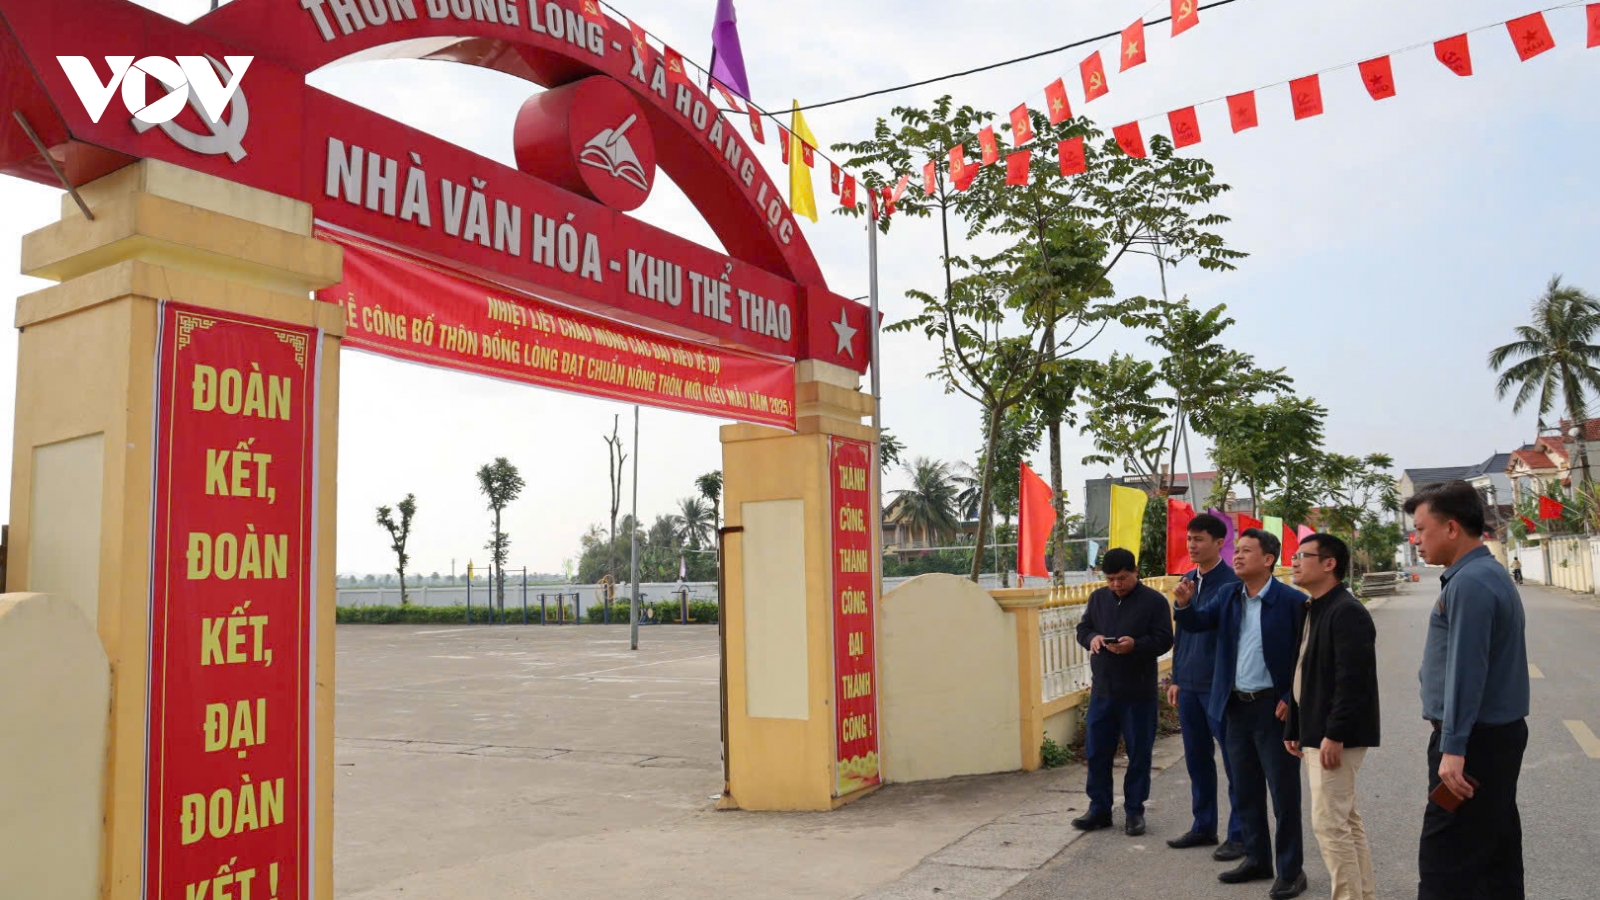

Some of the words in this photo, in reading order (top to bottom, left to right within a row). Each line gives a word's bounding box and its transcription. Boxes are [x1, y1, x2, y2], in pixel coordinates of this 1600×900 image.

[325, 136, 431, 227] NHÀ
[440, 176, 522, 257] VĂN
[533, 211, 602, 283] HÓA
[627, 248, 682, 307] KHU
[689, 263, 732, 324] THỂ
[738, 288, 791, 342] THAO
[756, 181, 794, 244] LỘC
[487, 297, 527, 330] NHIỆT
[528, 308, 556, 337] LIỆT
[557, 316, 592, 342] CHÀO
[362, 304, 407, 341] CÔNG
[412, 313, 435, 346] BỐ
[439, 324, 478, 356] THÔN
[524, 339, 559, 371] LÒNG
[561, 352, 585, 380] ĐẠT
[588, 354, 625, 386] CHUẨN
[627, 364, 656, 391] NÔNG
[658, 372, 683, 397] THÔN
[749, 390, 769, 413] NĂM
[192, 362, 291, 421] ĐOÀN
[205, 437, 276, 504] KẾT,
[839, 462, 866, 491] THÀNH
[840, 503, 866, 535] CÔNG,
[186, 524, 288, 580] ĐOÀN
[840, 544, 868, 573] THÀNH
[841, 586, 868, 615] CÔNG,
[201, 600, 273, 667] KẾT,
[848, 631, 864, 661] ĐẠI
[842, 669, 871, 699] THÀNH
[204, 698, 266, 759] ĐẠI
[842, 711, 867, 743] CÔNG
[180, 774, 284, 845] ĐOÀN
